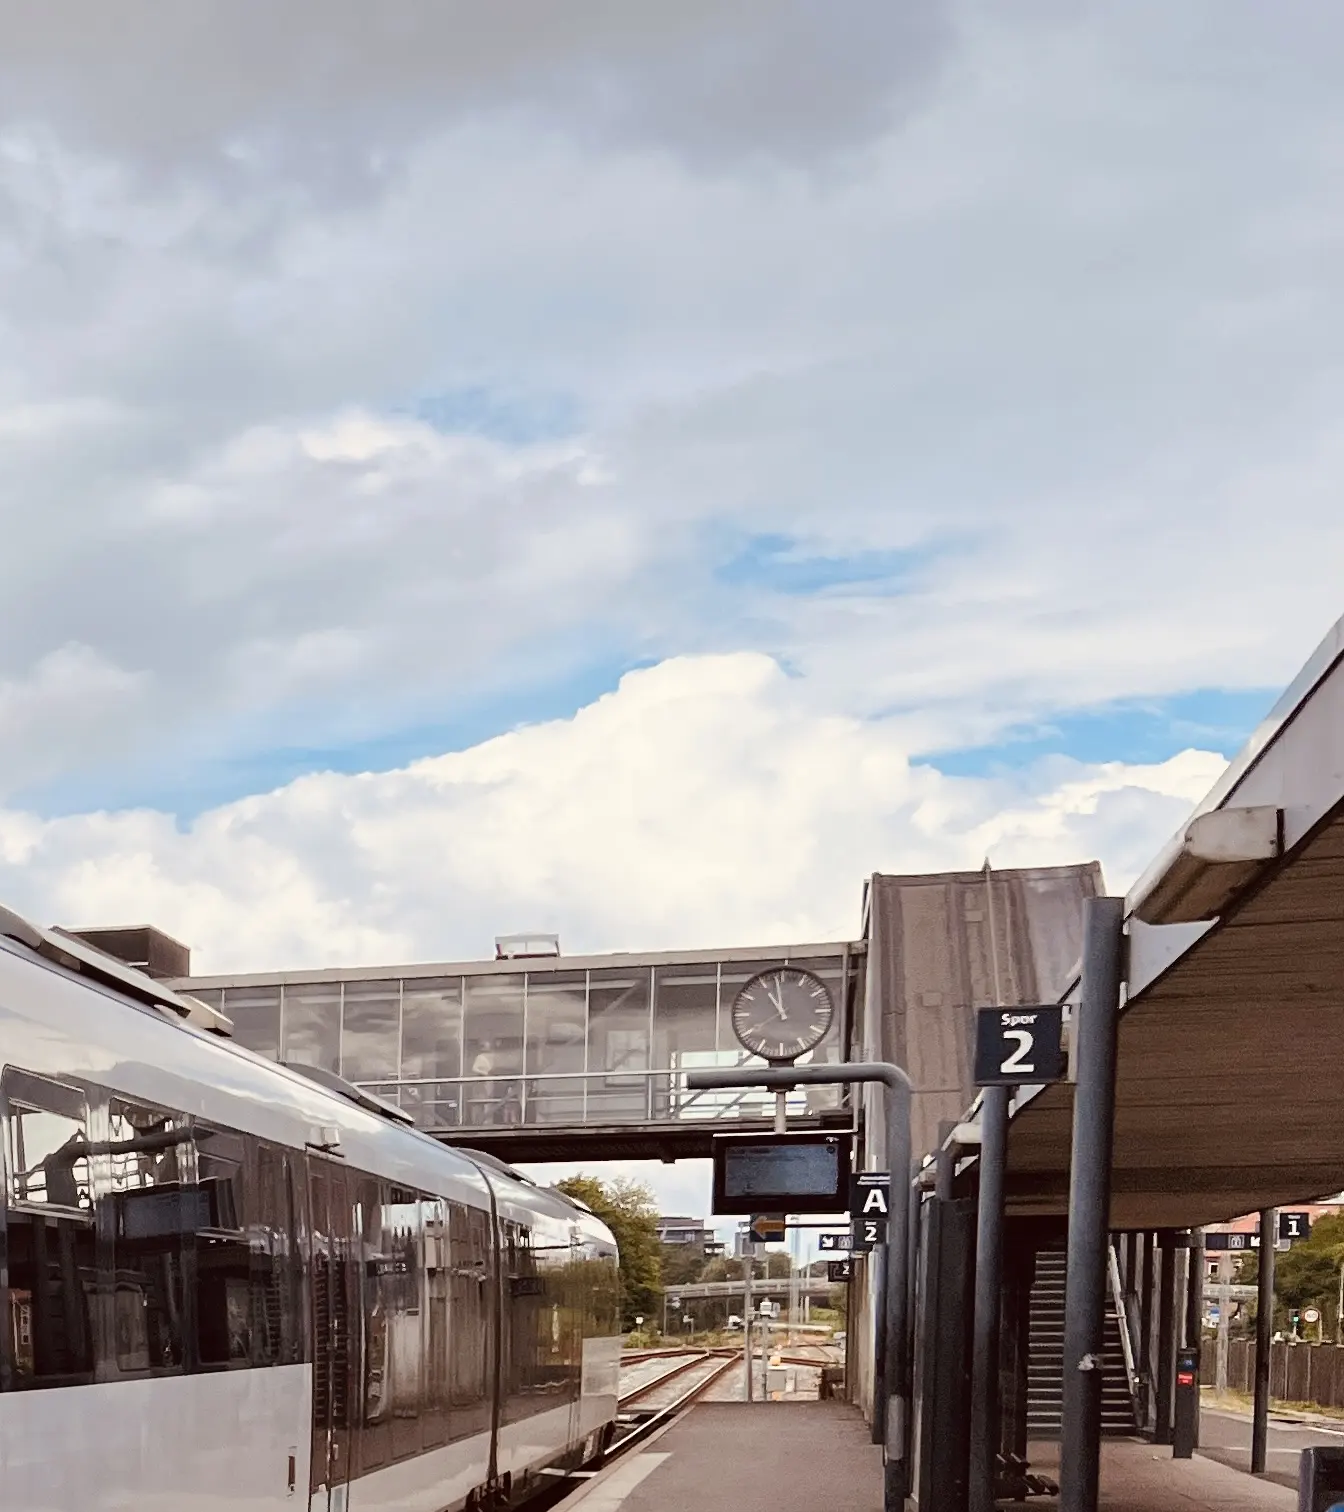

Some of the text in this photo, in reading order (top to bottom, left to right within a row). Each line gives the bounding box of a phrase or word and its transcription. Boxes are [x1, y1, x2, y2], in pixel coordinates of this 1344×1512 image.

[1000, 1013, 1038, 1027] Spor
[1000, 1030, 1035, 1074] 2
[862, 1188, 888, 1213] A
[864, 1226, 878, 1242] 2
[1287, 1219, 1301, 1237] 1
